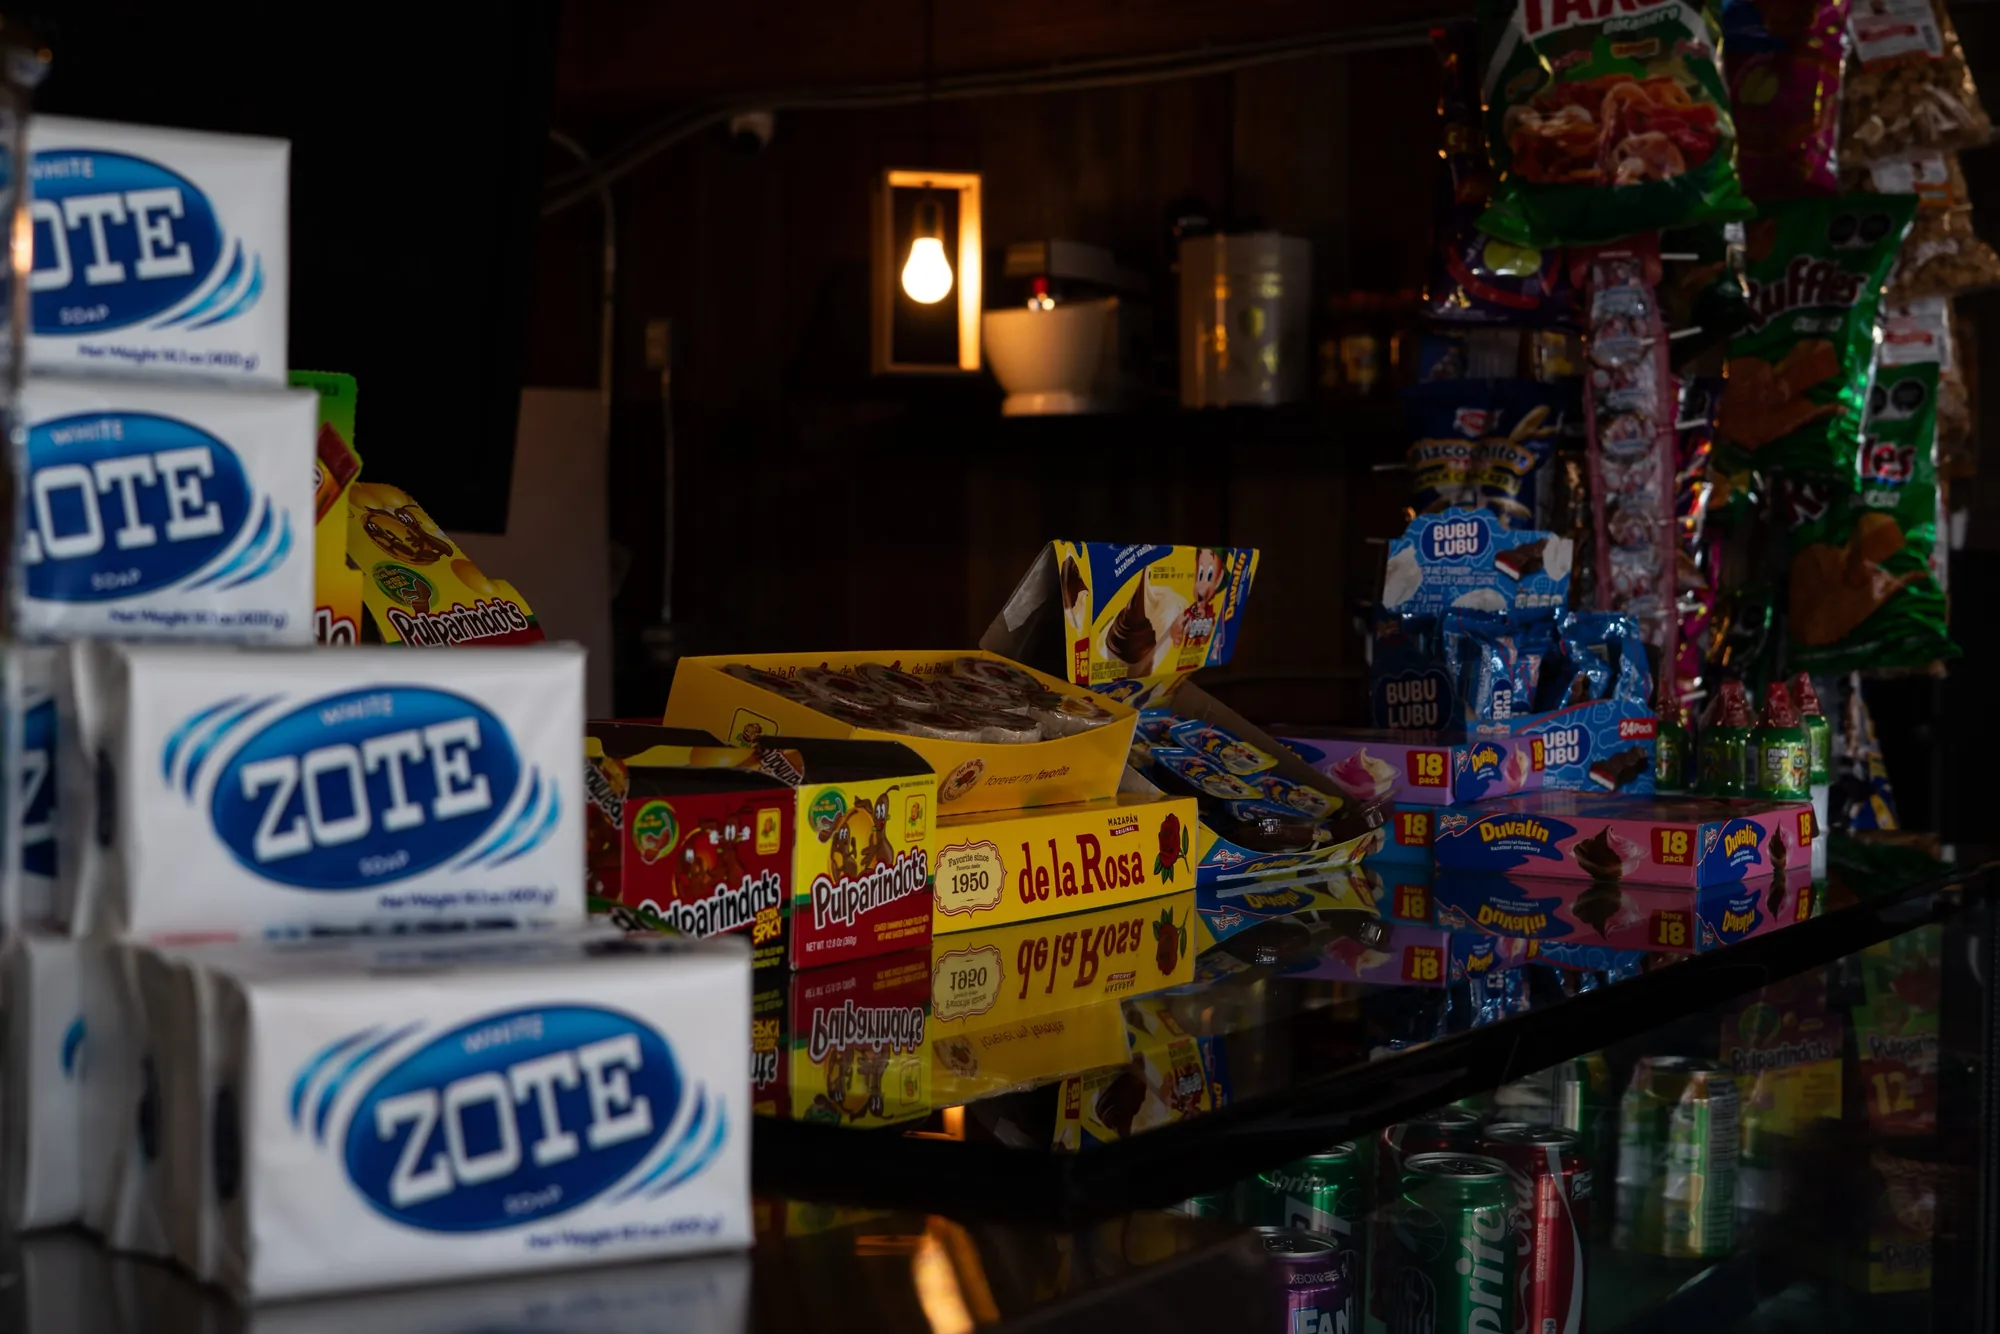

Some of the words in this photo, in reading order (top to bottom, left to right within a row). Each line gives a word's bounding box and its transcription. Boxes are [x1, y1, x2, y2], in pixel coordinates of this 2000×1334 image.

[30, 187, 195, 291] OTE
[1433, 521, 1479, 541] BUBU
[1434, 538, 1479, 557] LUBU
[389, 602, 528, 648] Pulparindots
[1386, 678, 1437, 703] BUBU
[1388, 702, 1438, 728] LUBU
[1493, 690, 1503, 720] LUB
[1503, 688, 1512, 719] BUB
[1543, 728, 1579, 748] UBU
[1416, 753, 1443, 776] 18
[1544, 746, 1580, 766] UBU
[985, 775, 1020, 788] forever
[1035, 765, 1070, 781] favorite
[1418, 777, 1440, 786] pack
[238, 716, 493, 865] ZOTE
[1107, 814, 1138, 826] MAZAPÁN
[1403, 813, 1428, 836] 18
[1799, 812, 1811, 836] 18
[1660, 830, 1688, 853] 18
[1018, 841, 1050, 904] de
[1048, 838, 1079, 898] la
[1076, 833, 1145, 894] Rosa
[1662, 855, 1685, 865] pack
[811, 847, 928, 931] Pulparindots
[952, 871, 989, 894] 1950
[752, 917, 782, 945] SPICY
[1871, 1071, 1917, 1116] 12
[374, 1032, 654, 1209] ZOTE
[1265, 1169, 1327, 1195] Sprite
[1455, 1206, 1506, 1334] prite
[1296, 1298, 1351, 1334] FAN
